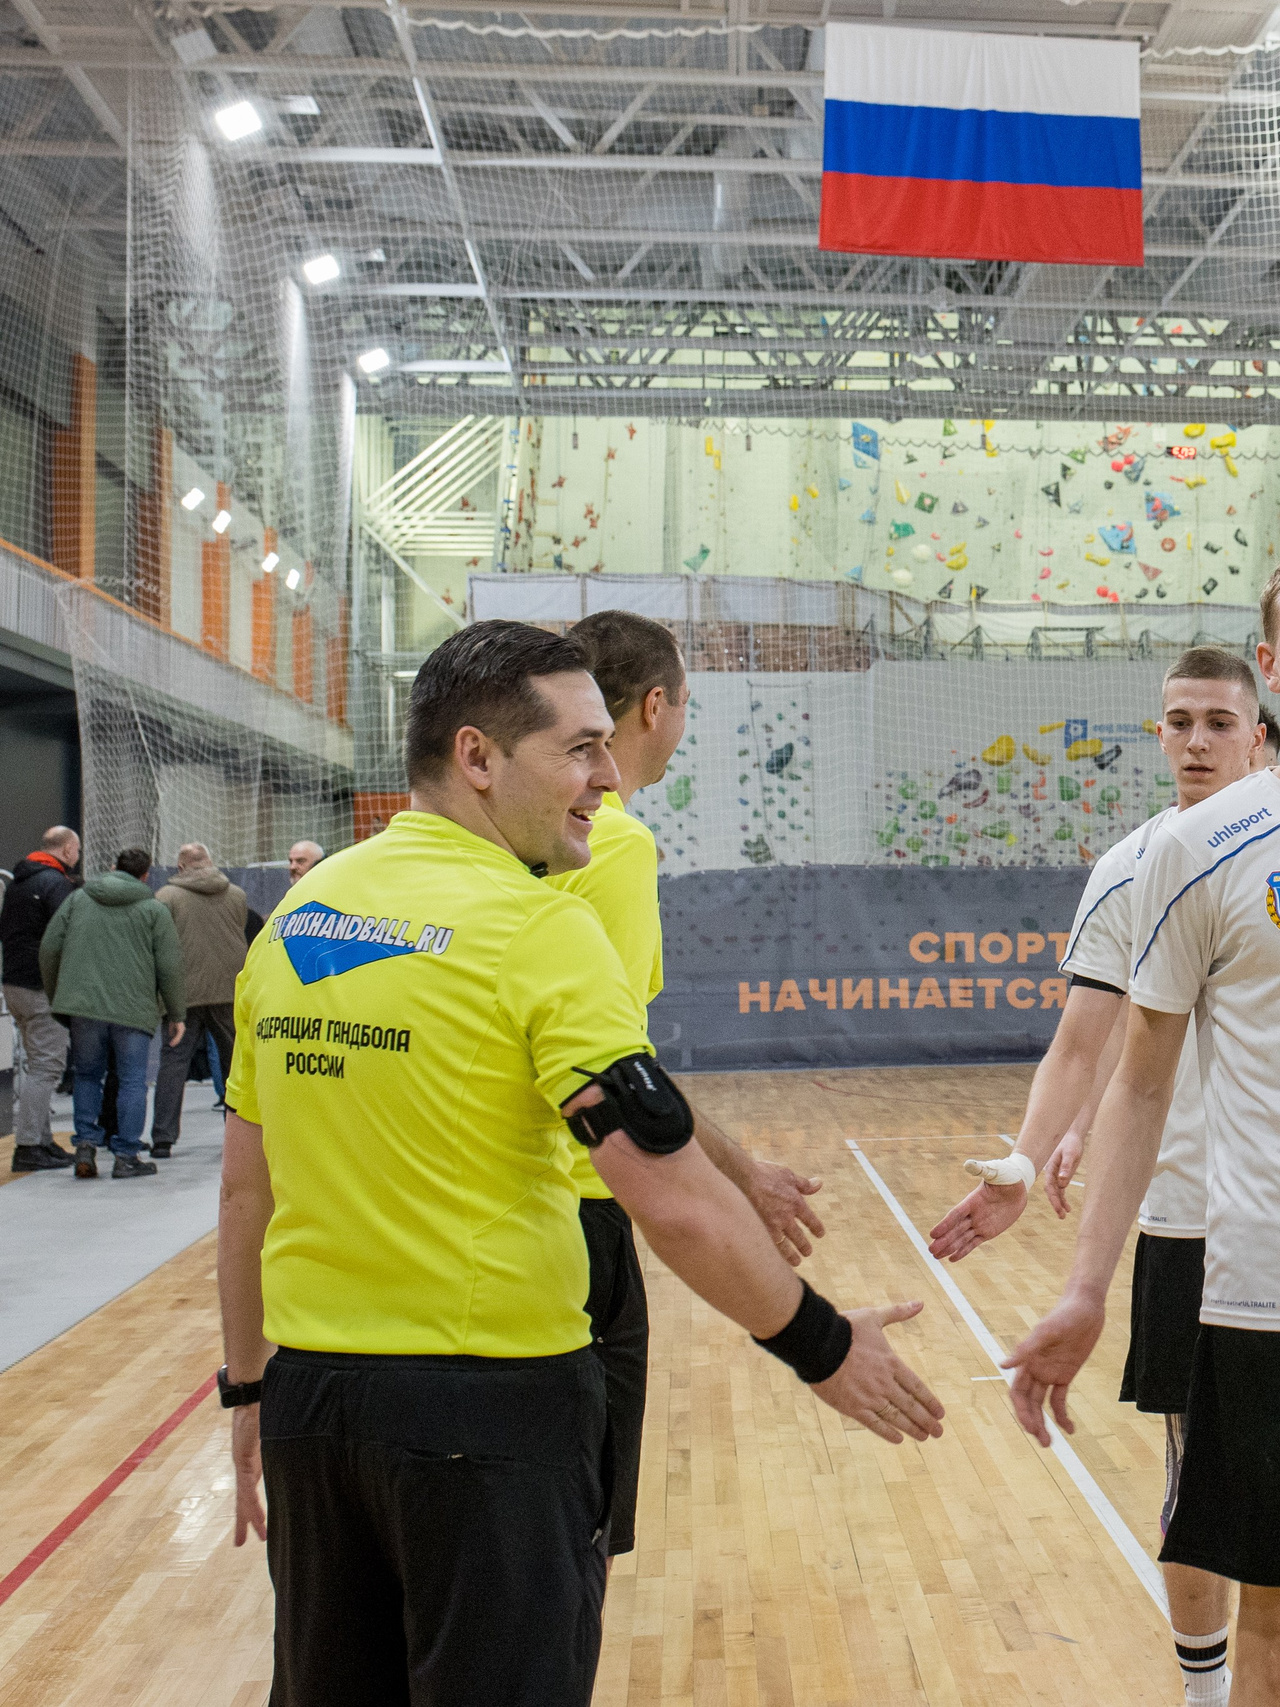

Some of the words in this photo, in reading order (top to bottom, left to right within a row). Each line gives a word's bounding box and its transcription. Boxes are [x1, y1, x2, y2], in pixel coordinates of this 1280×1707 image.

[1207, 807, 1272, 848] uhlsport
[738, 977, 1067, 1014] НАЧИНАЕТСЯ
[256, 1016, 323, 1044] ФЕДЕРАЦИЯ
[326, 1020, 411, 1053] ГАНДБОЛА
[286, 1051, 345, 1079] РОССИИ
